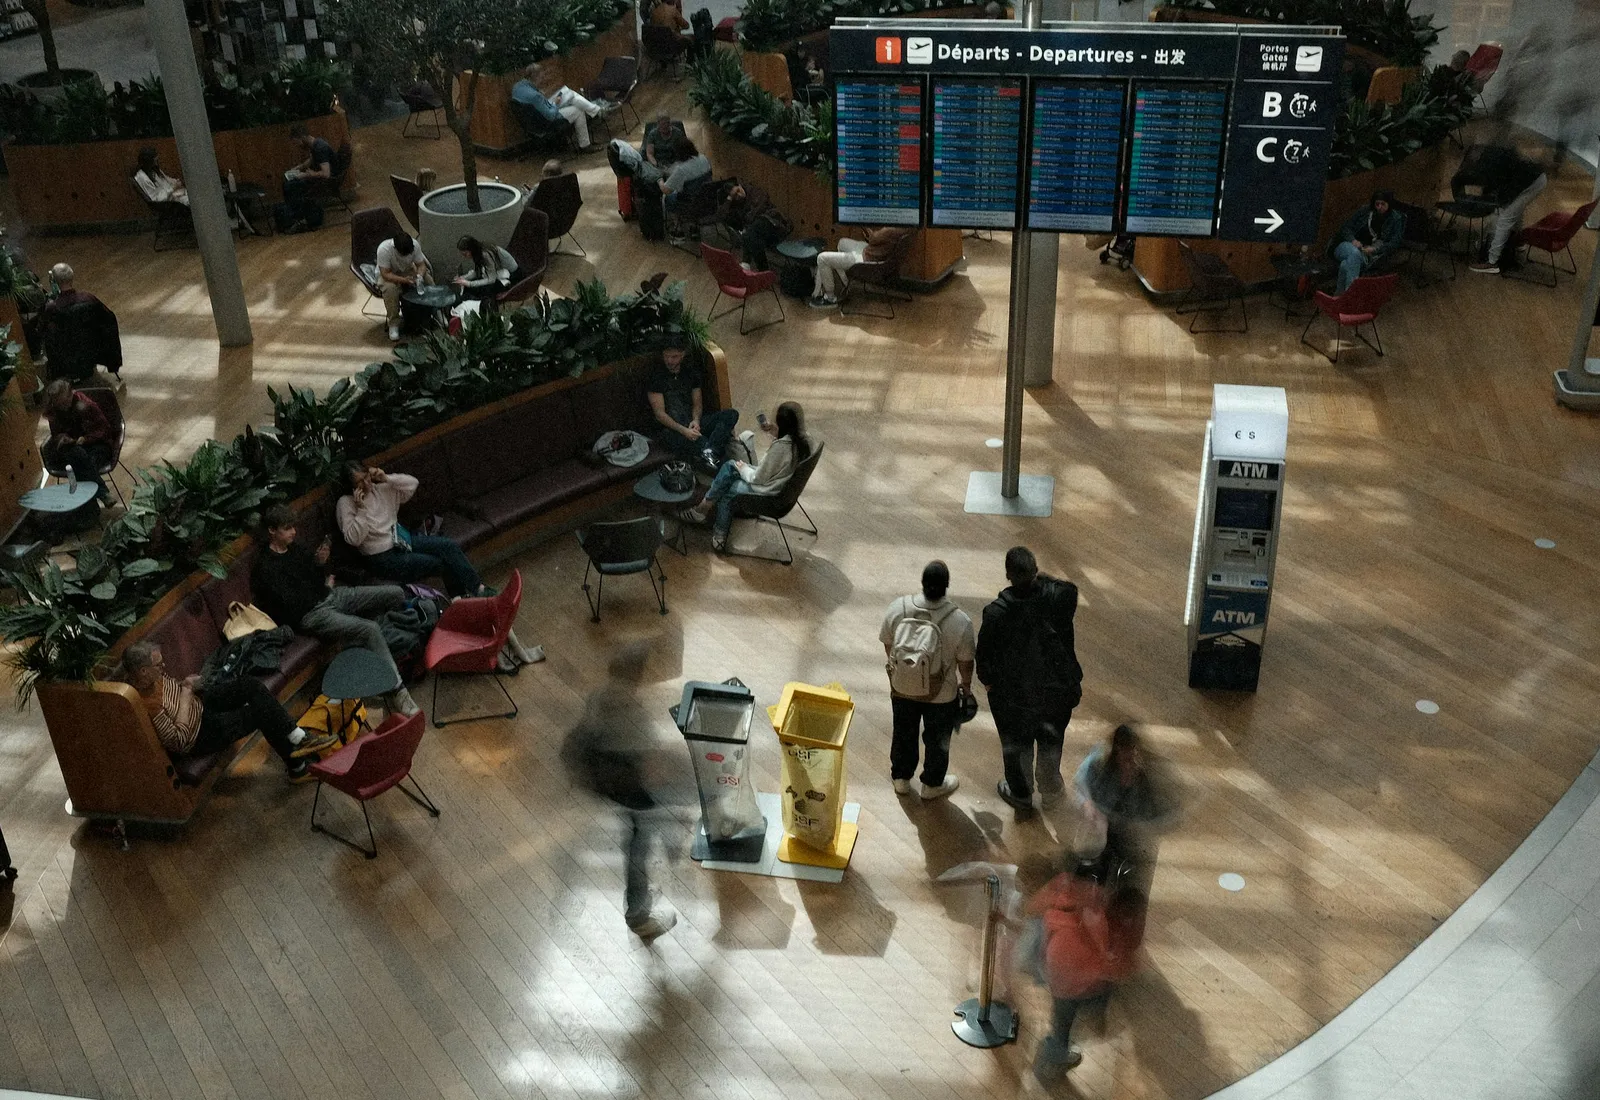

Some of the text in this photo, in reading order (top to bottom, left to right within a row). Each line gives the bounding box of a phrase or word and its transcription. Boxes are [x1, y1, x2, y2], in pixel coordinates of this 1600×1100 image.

[938, 44, 1010, 63] Départs
[1029, 45, 1134, 65] Departures
[1260, 44, 1289, 53] Portes
[1154, 49, 1185, 65] 出发
[1262, 53, 1288, 61] Gates
[1262, 91, 1283, 117] B
[1296, 101, 1307, 110] 11
[1256, 137, 1278, 163] C
[1293, 147, 1299, 156] 7
[1230, 462, 1268, 478] ATM
[1212, 610, 1255, 624] ATM
